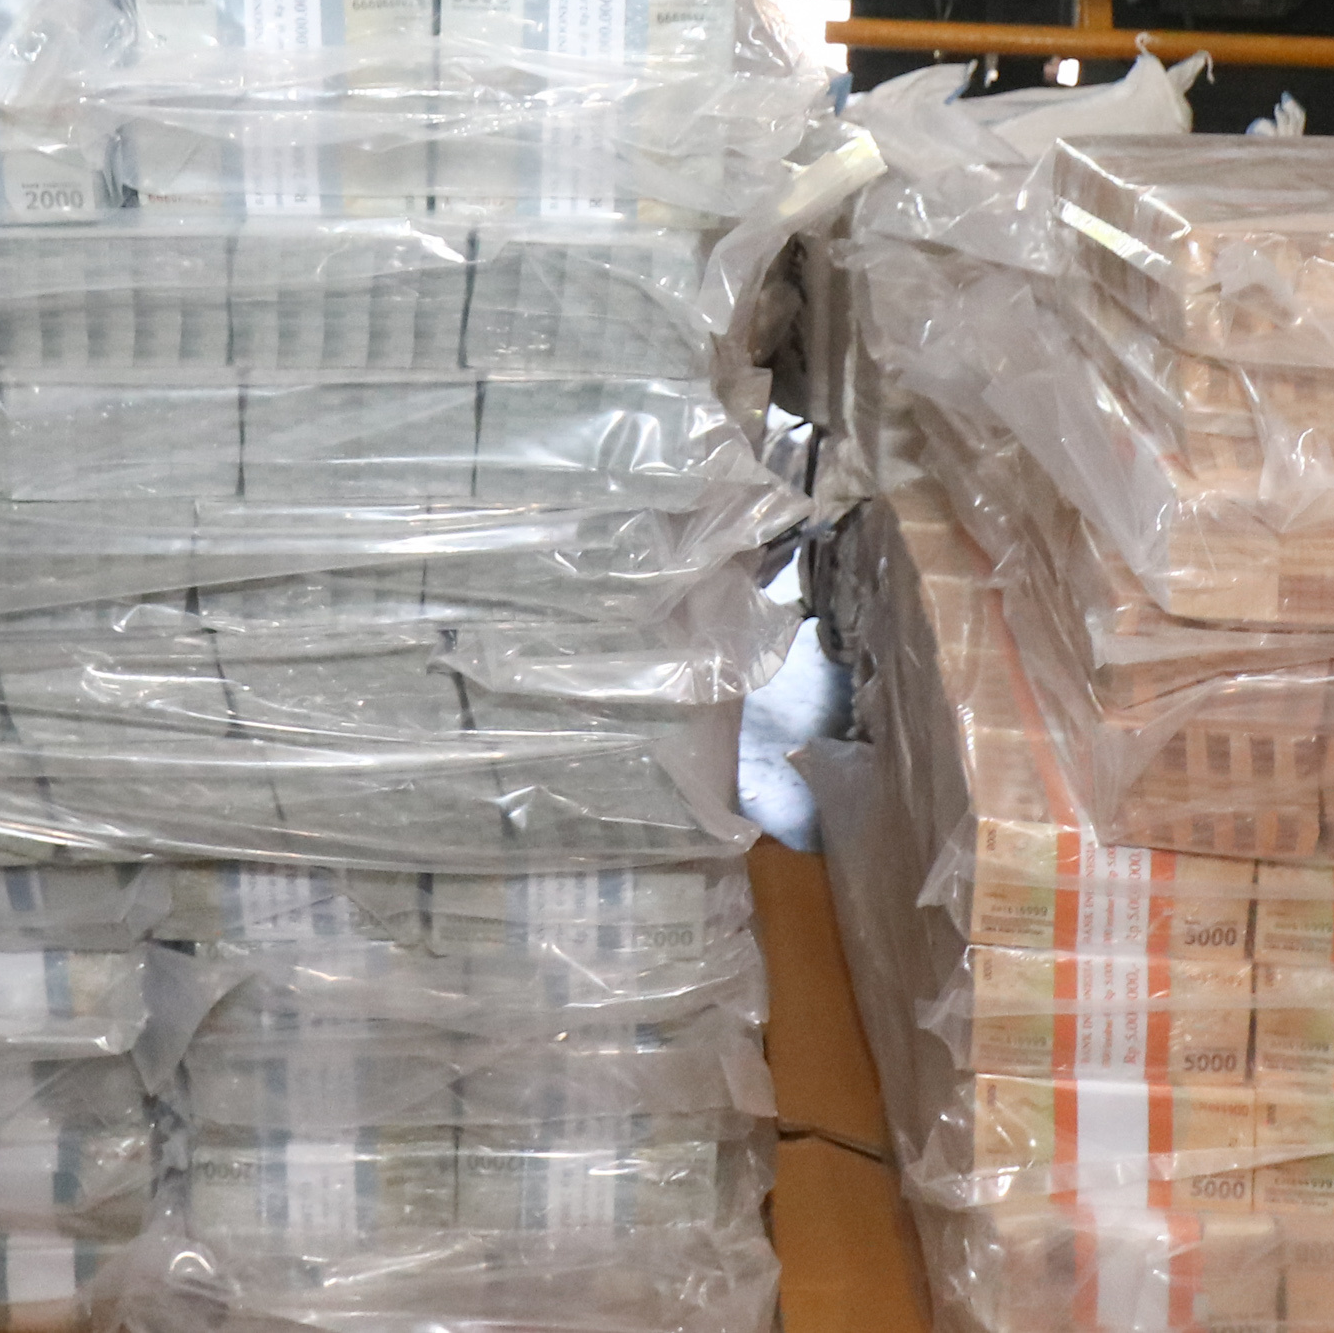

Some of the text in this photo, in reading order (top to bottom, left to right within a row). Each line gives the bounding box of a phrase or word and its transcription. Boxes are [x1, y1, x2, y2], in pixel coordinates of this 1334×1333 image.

[24, 190, 84, 210] 2000
[1184, 927, 1237, 947] 5000
[1124, 1046, 1140, 1064] Rp
[1184, 1053, 1237, 1072] 5000
[1191, 1178, 1246, 1199] 5000
